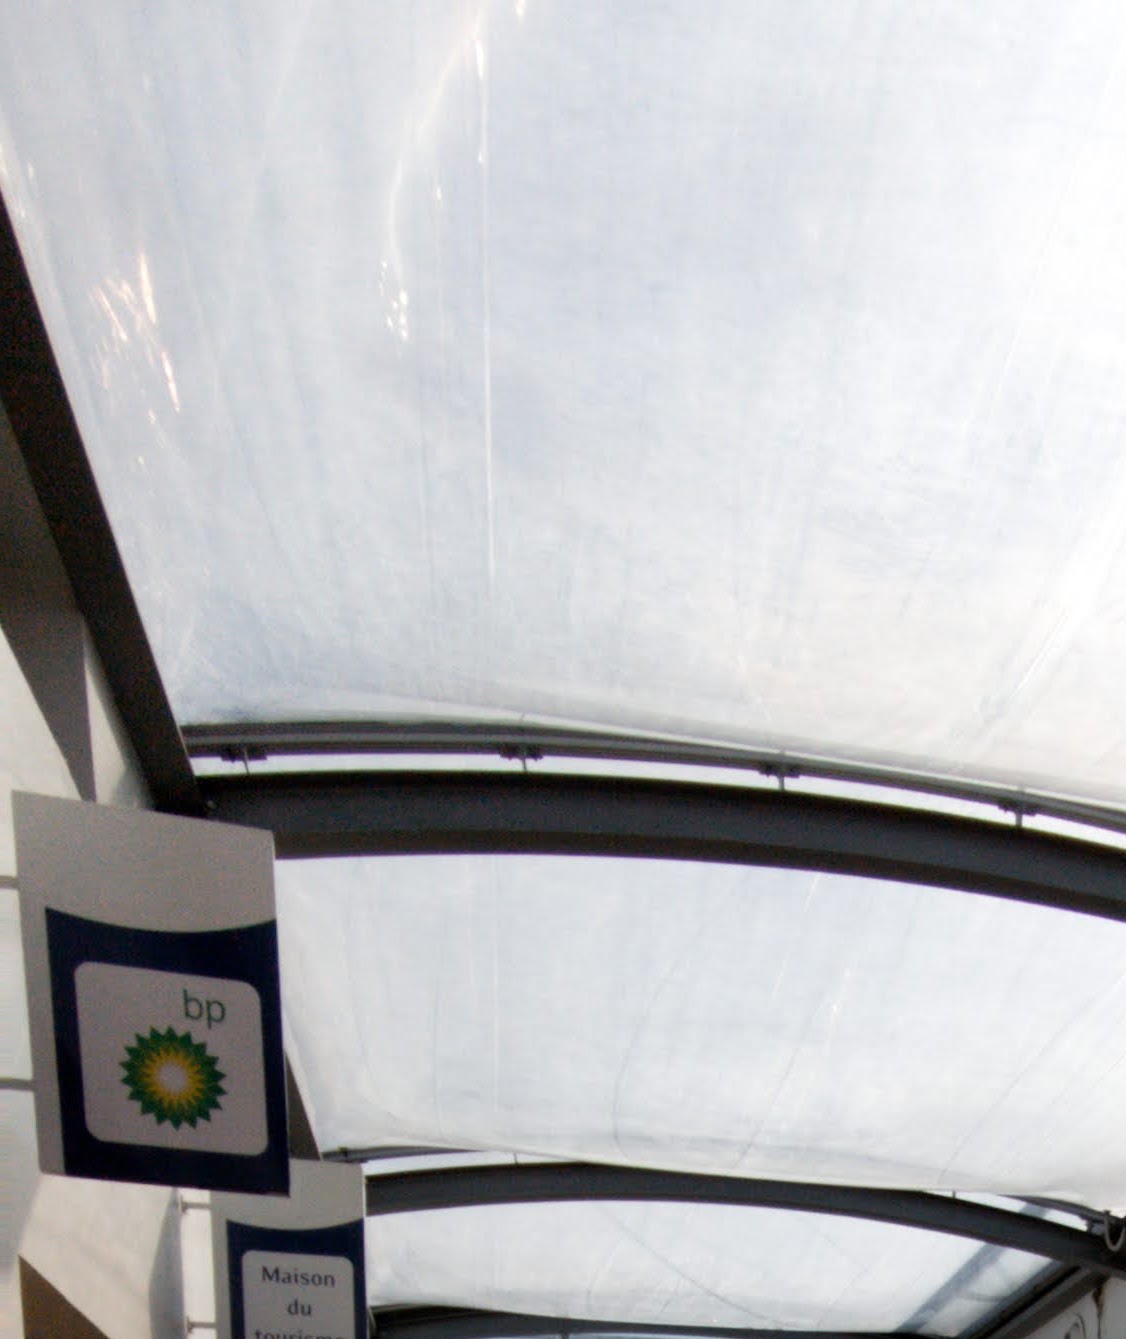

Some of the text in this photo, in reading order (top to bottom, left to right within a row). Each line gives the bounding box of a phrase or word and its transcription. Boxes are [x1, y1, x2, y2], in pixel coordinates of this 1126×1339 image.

[183, 990, 226, 1029] bp
[261, 1266, 335, 1291] Maison
[287, 1298, 312, 1318] du
